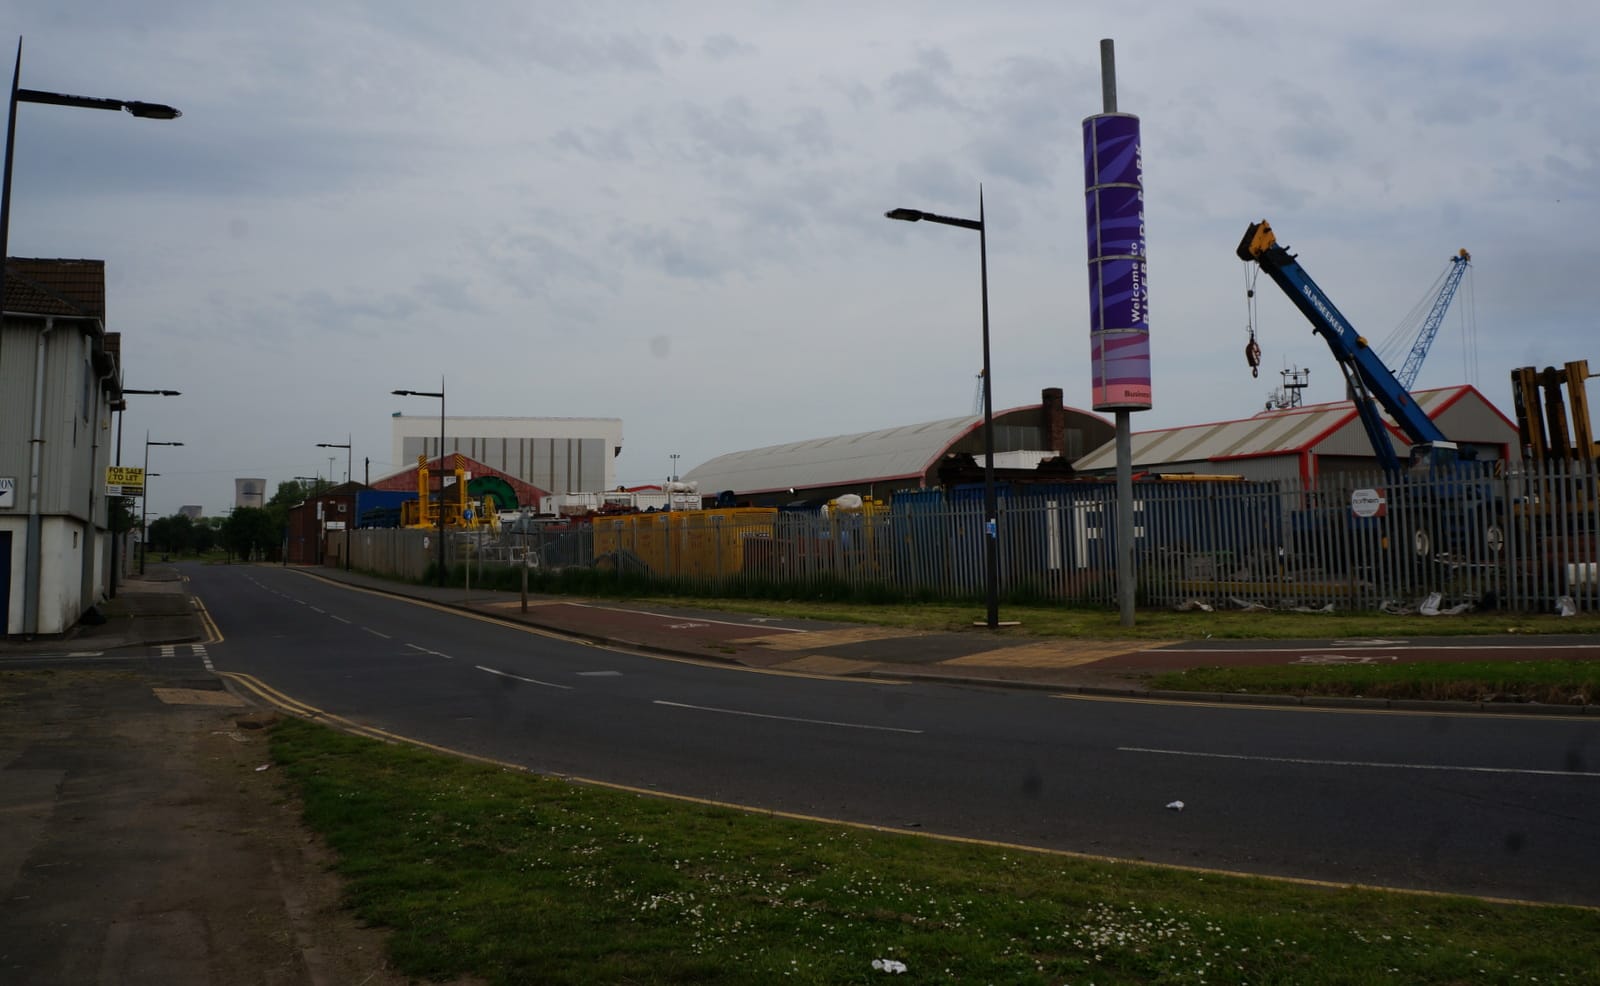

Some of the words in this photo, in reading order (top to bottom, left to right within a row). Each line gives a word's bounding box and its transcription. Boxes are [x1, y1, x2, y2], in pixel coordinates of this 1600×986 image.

[1131, 242, 1139, 256] to
[1131, 262, 1141, 323] Welcome
[126, 467, 143, 475] SALE
